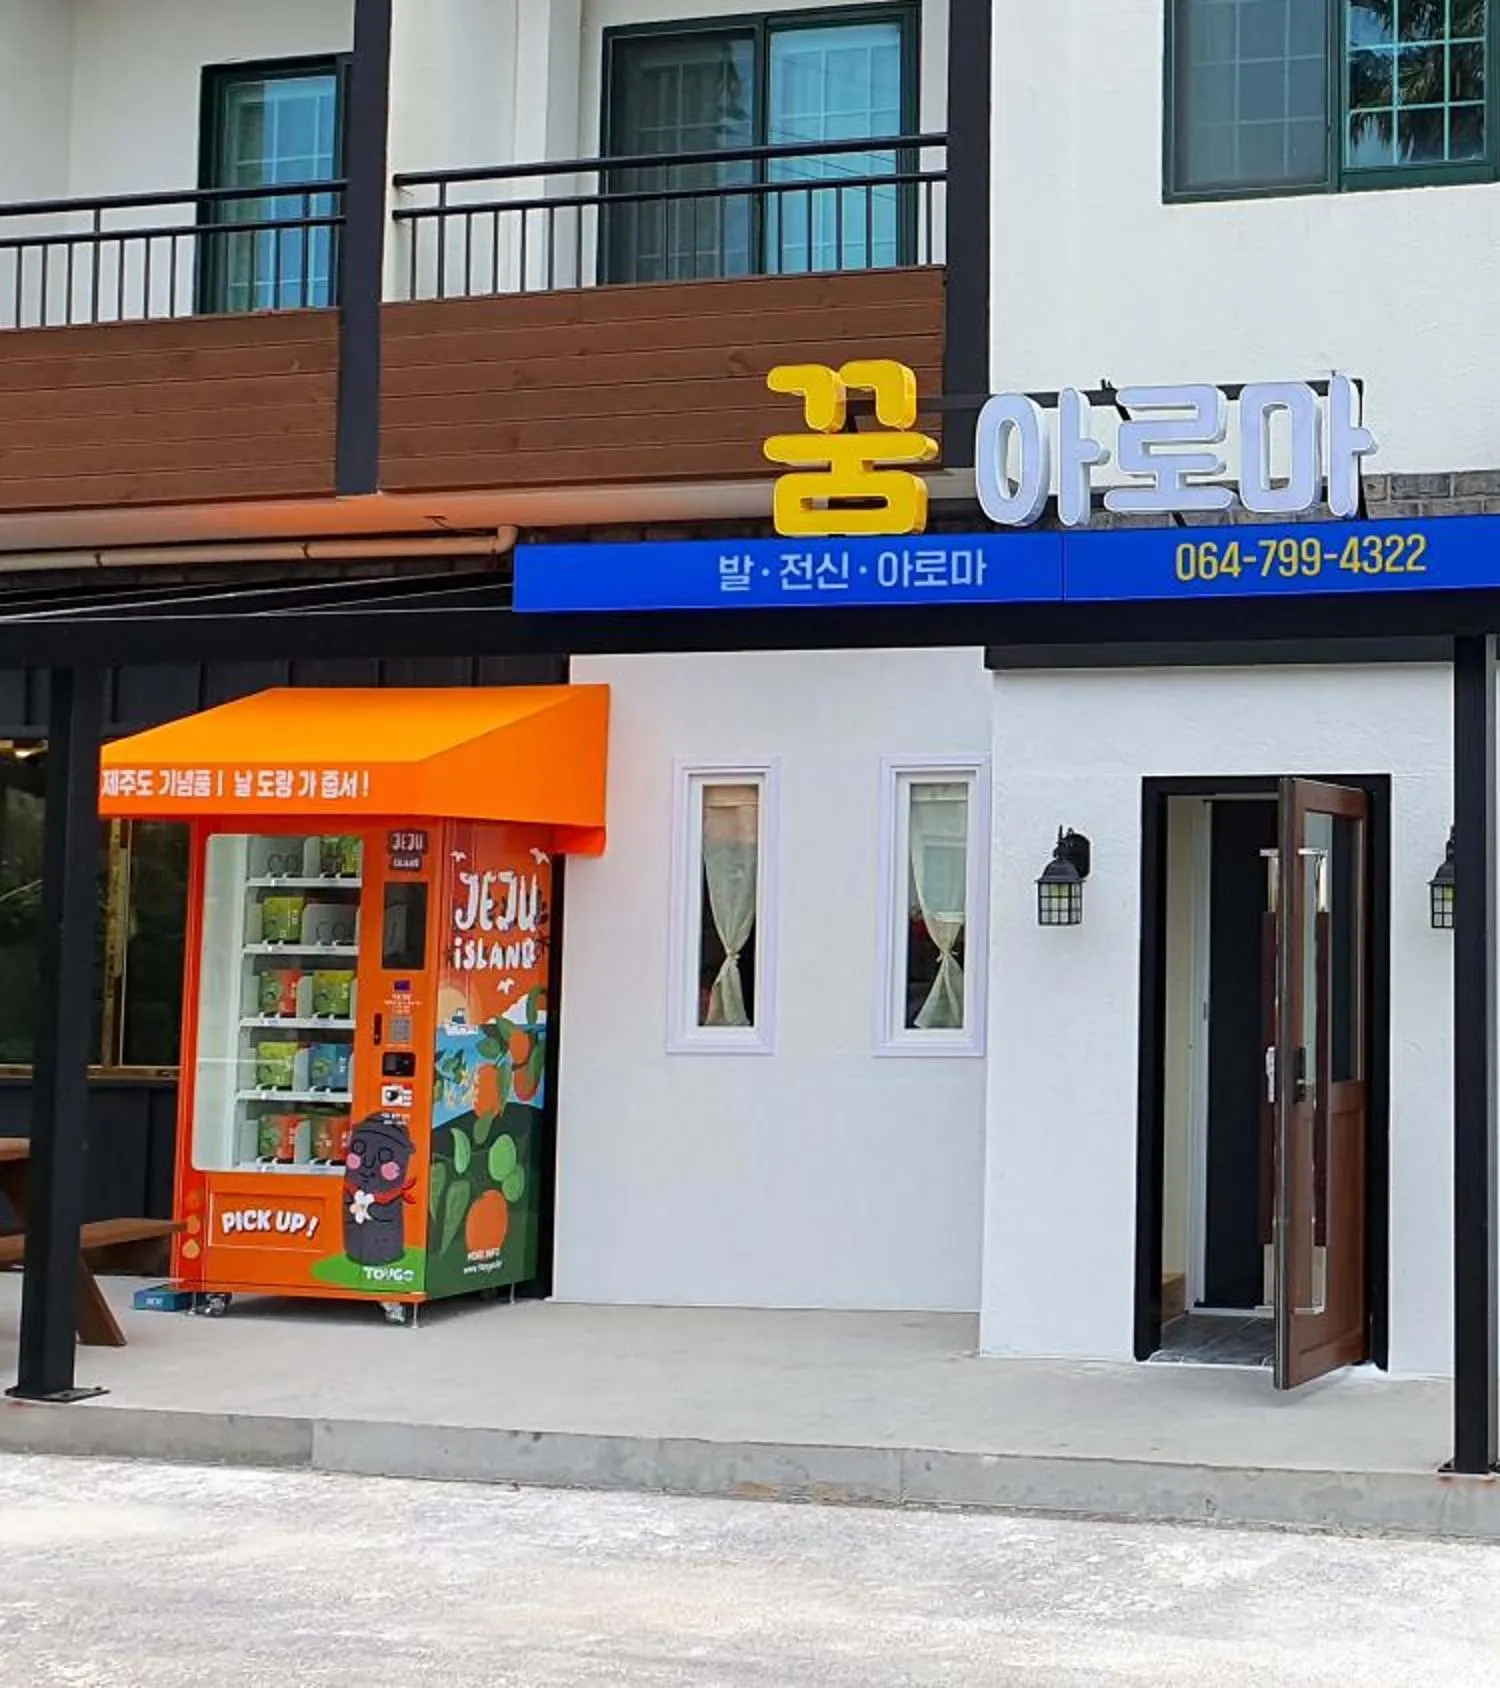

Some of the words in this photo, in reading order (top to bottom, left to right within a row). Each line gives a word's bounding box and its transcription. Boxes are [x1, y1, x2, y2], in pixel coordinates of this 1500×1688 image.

[762, 359, 940, 537] 꿈
[975, 374, 1379, 528] 아로마
[1175, 533, 1428, 582] 064-799-4322
[102, 769, 153, 797] 제주도
[159, 769, 211, 797] 기념품
[233, 769, 253, 797] 날
[256, 769, 294, 798] 도랑
[298, 769, 317, 798] 가
[391, 832, 424, 851] JEJU
[455, 870, 539, 932] JEJU
[222, 1209, 272, 1234] PICK
[275, 1210, 319, 1237] UP!
